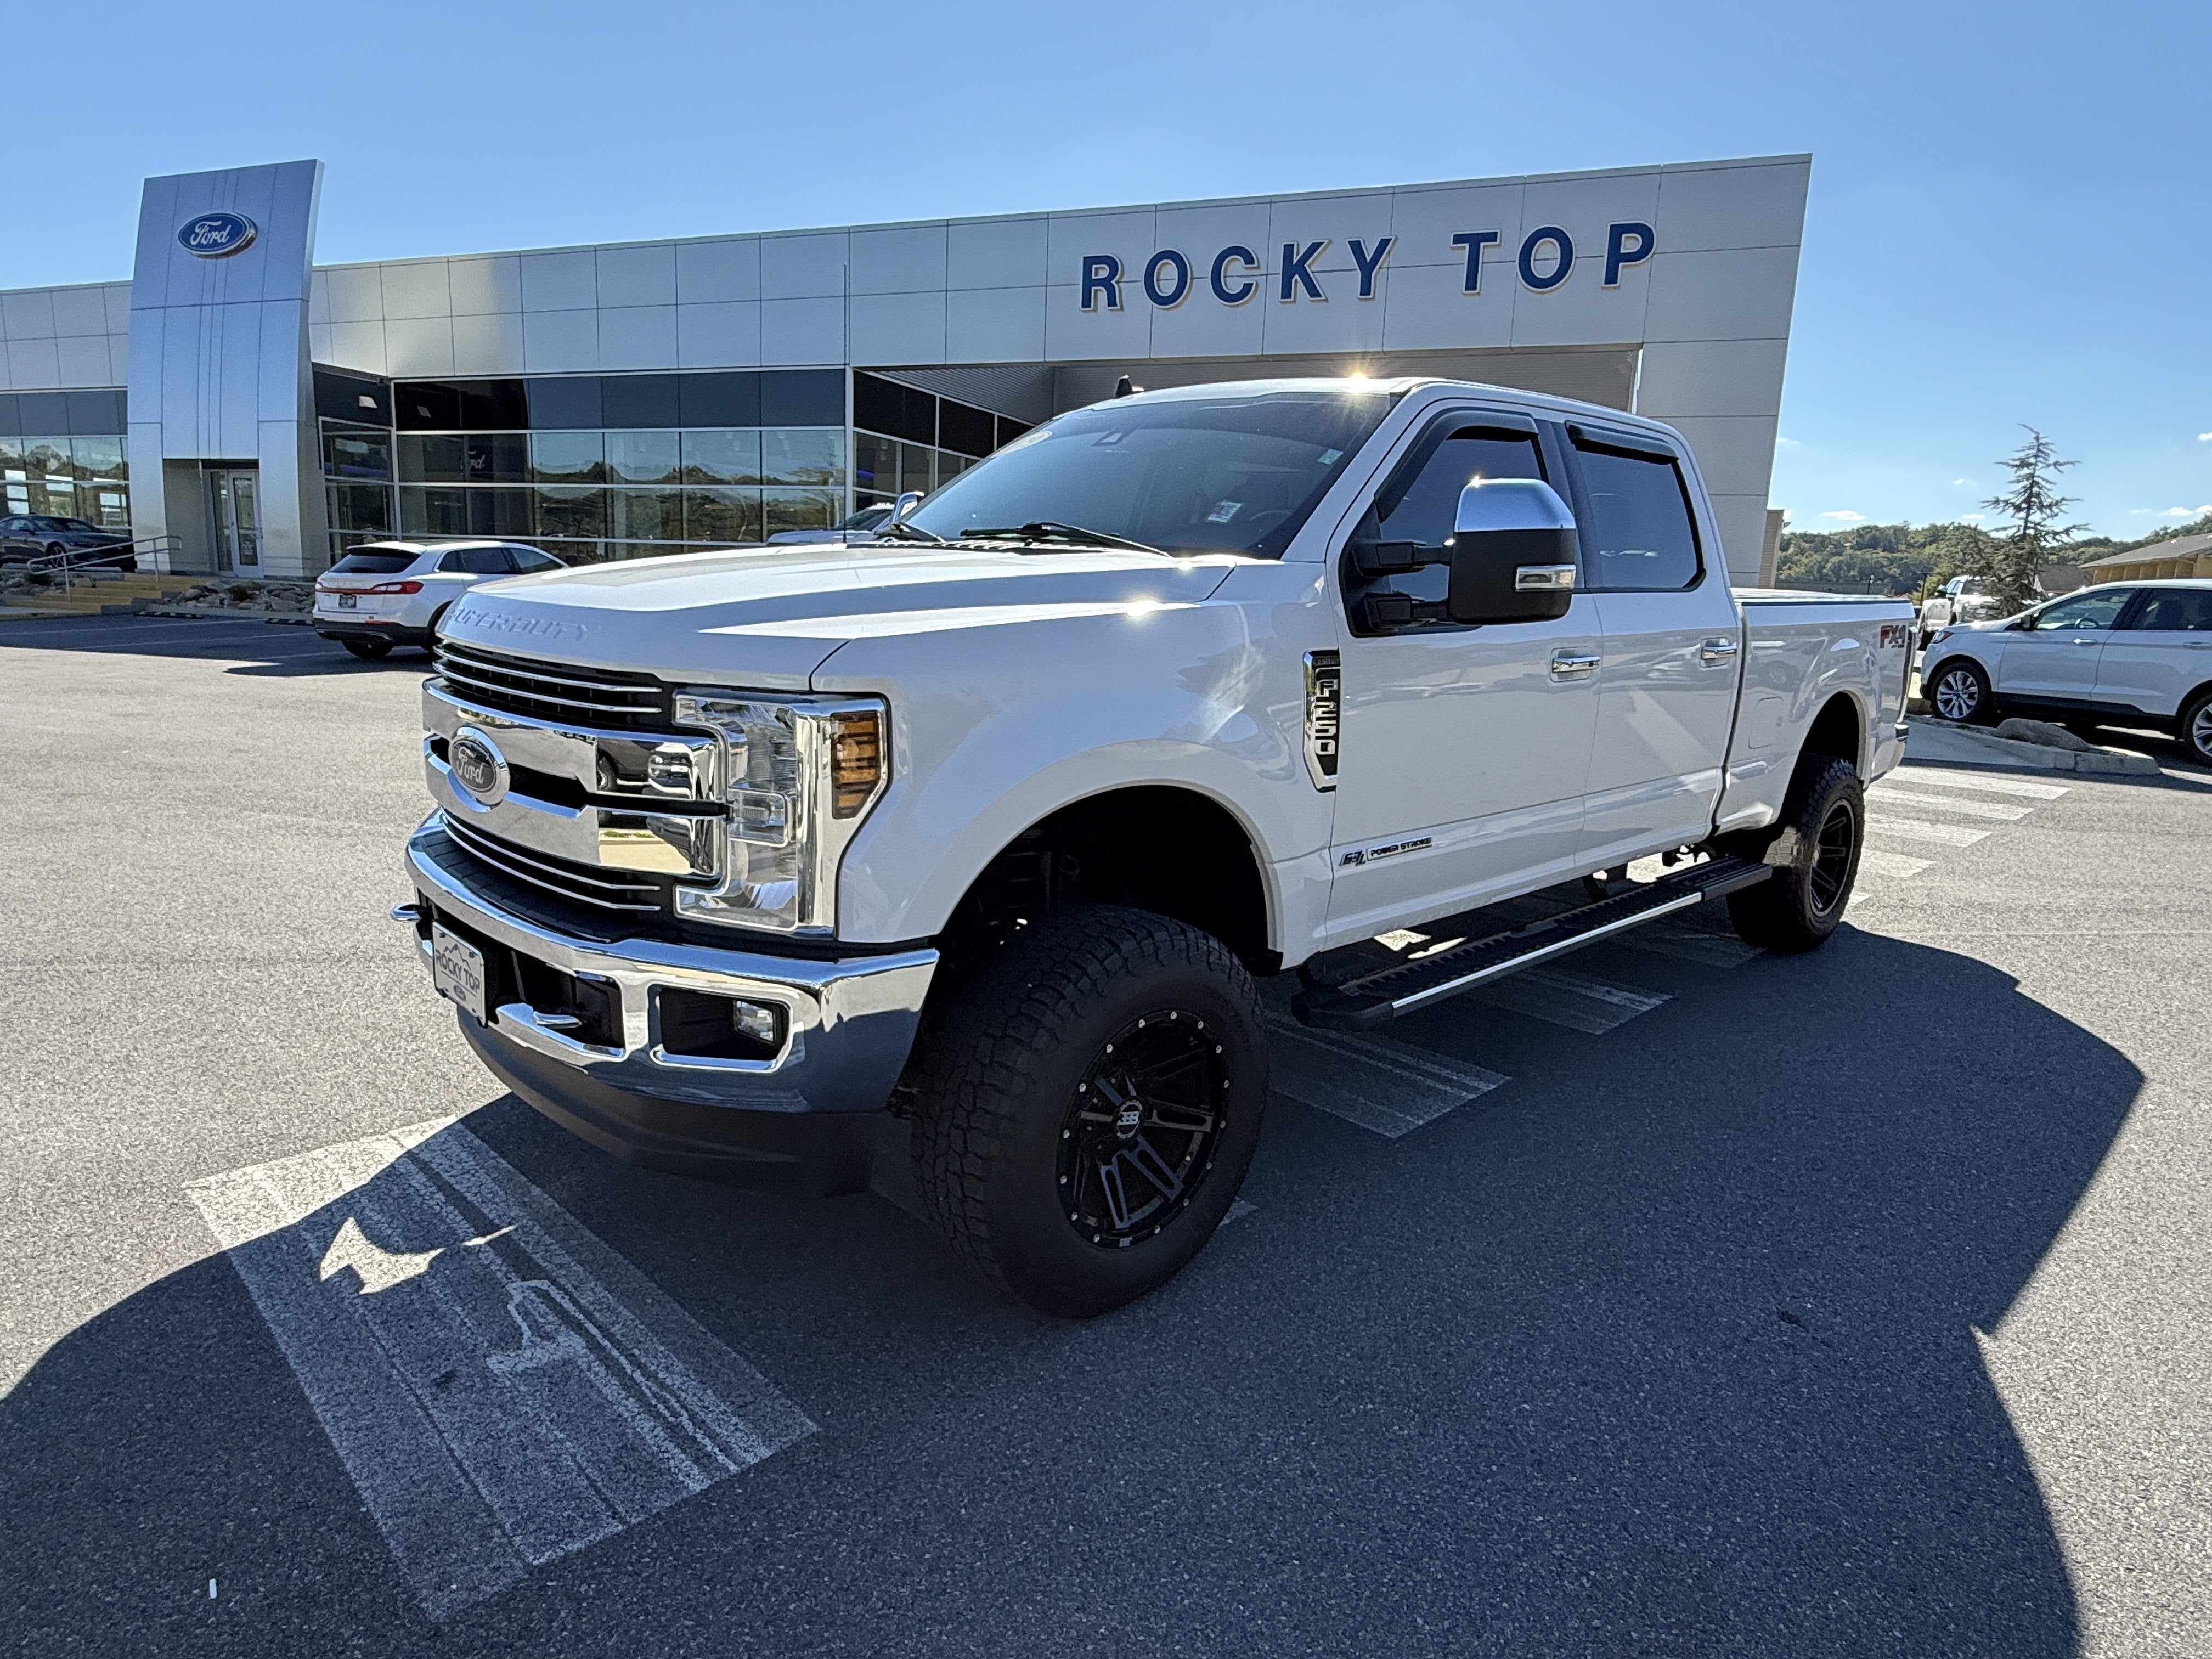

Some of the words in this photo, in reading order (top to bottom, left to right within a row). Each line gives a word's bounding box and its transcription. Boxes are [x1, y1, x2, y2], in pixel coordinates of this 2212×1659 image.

[190, 221, 232, 246] Ford
[1079, 236, 1396, 311] ROCKY
[1452, 221, 1657, 295] TOP
[1880, 625, 1906, 648] FX4
[1316, 678, 1339, 755] F250
[456, 746, 484, 785] Ford
[1370, 844, 1399, 857] POWER
[1400, 837, 1432, 850] STROKE
[436, 948, 462, 981] ROCKY
[463, 967, 480, 994] TOP
